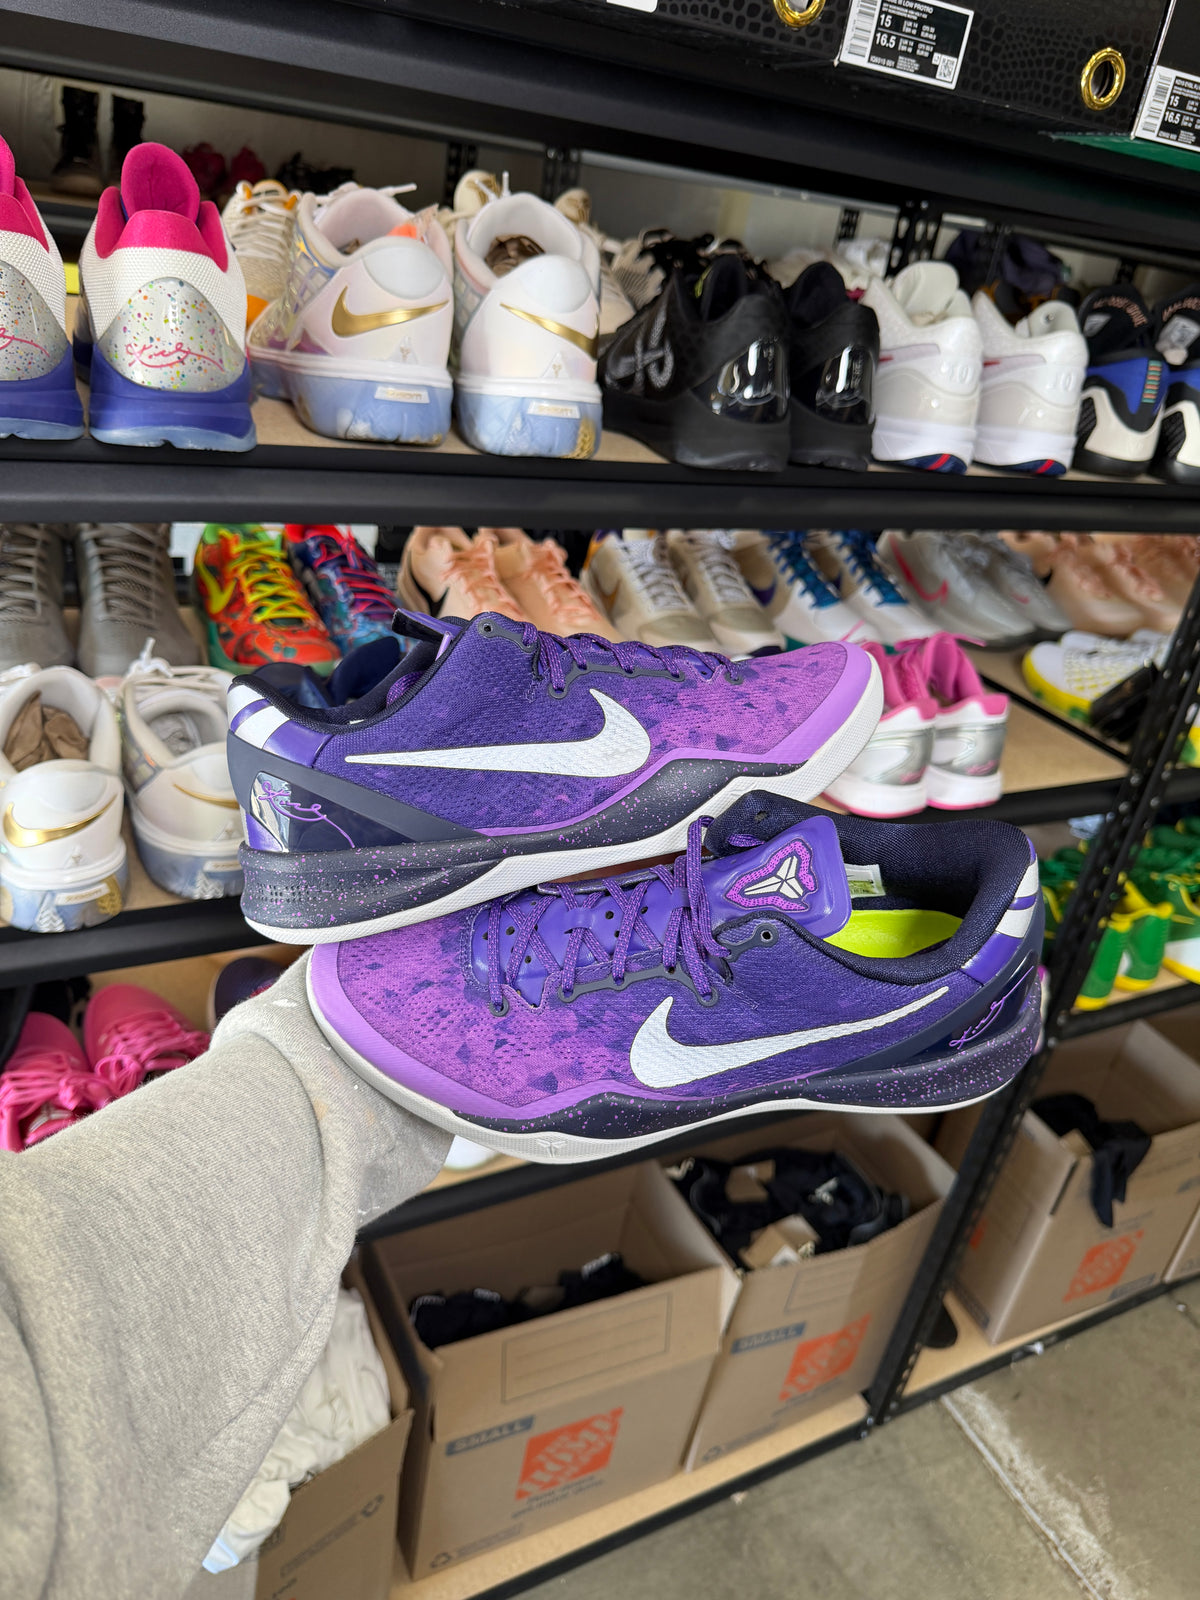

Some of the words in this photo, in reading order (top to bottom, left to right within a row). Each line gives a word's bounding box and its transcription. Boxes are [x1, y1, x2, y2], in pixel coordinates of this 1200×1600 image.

[880, 13, 893, 28] 15
[876, 32, 897, 49] 16.5
[1170, 95, 1180, 107] 15
[1164, 111, 1181, 124] 16.5
